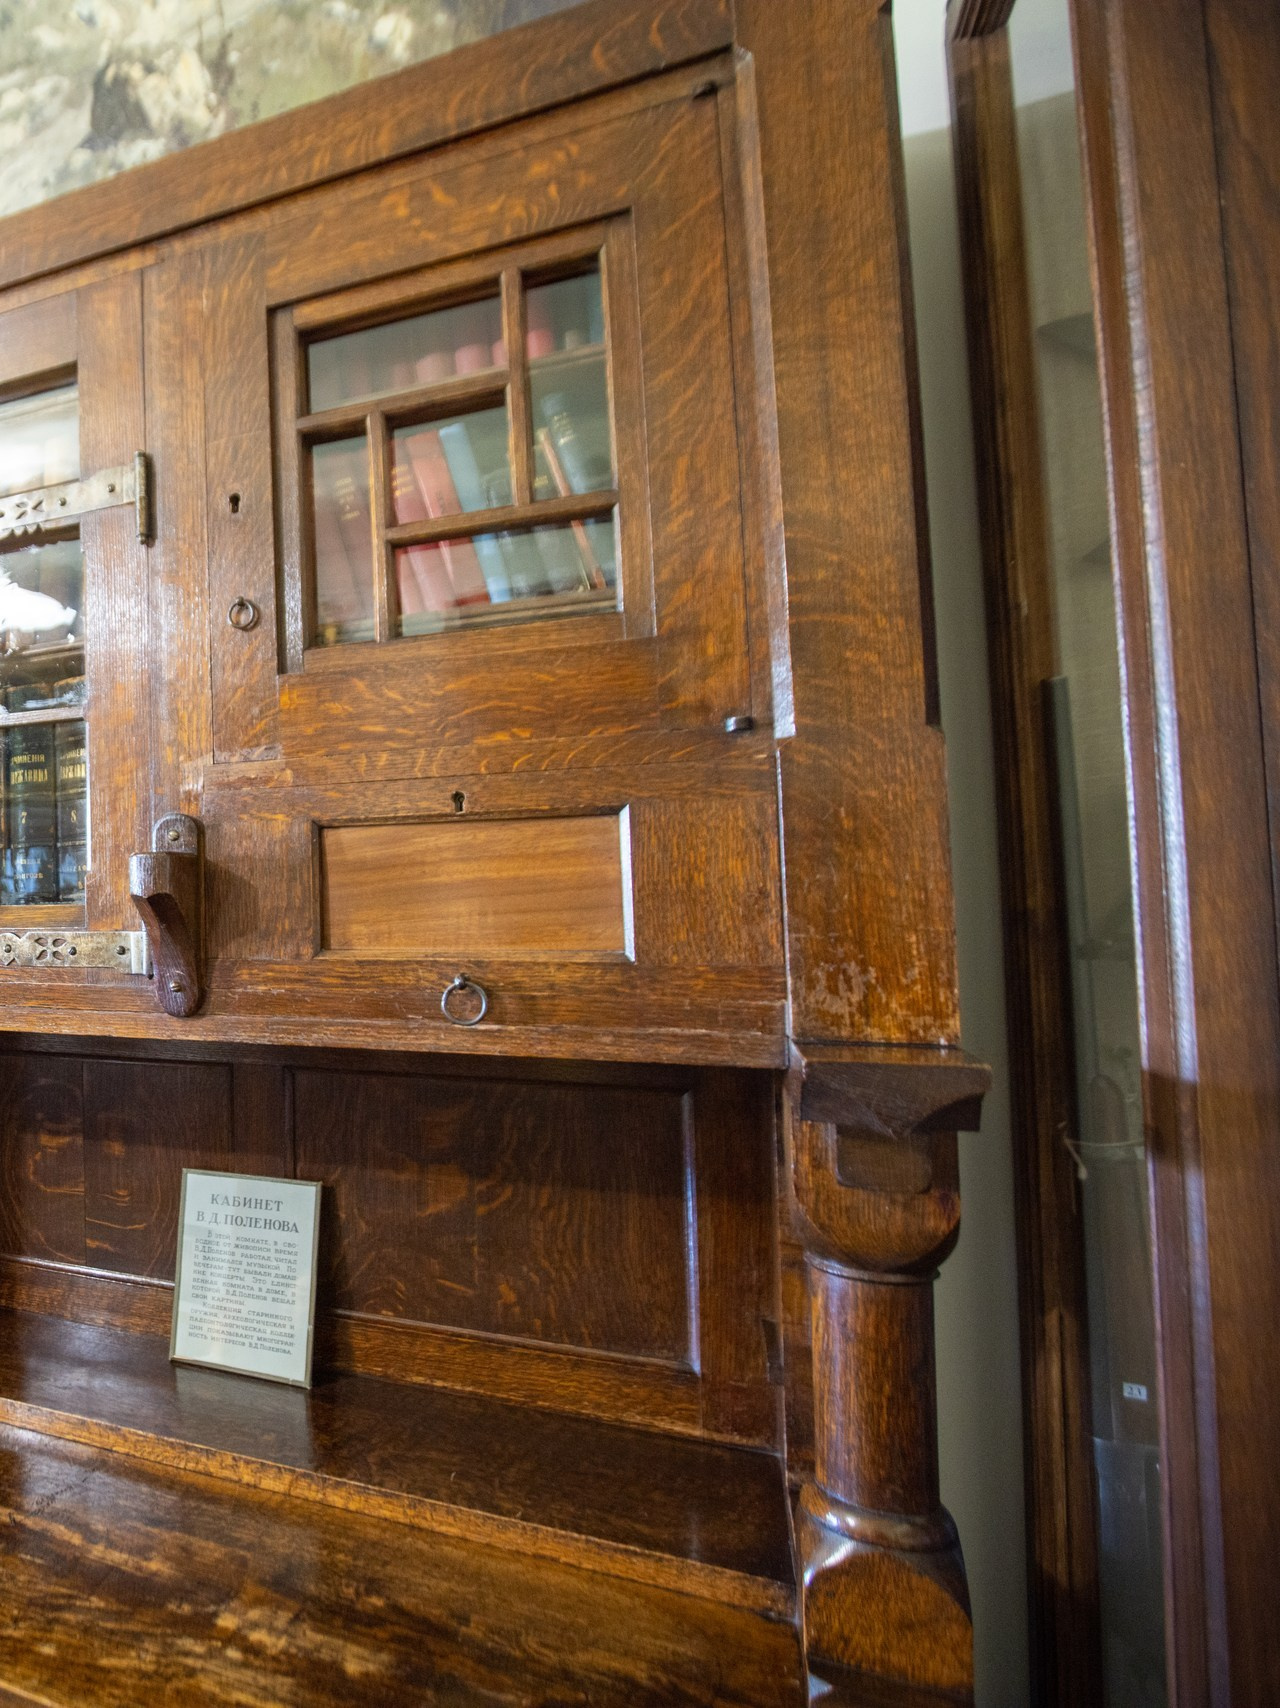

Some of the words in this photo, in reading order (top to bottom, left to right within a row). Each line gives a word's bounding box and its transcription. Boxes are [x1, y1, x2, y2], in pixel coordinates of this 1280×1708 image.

[20, 811, 28, 824] 7
[70, 809, 77, 823] 8
[211, 1194, 284, 1212] КАБИНЕТ
[224, 1214, 300, 1234] ПОЛЕНОВА
[207, 1230, 213, 1238] В
[195, 1238, 220, 1247] БОДНОЕ
[234, 1243, 271, 1253] ЖИВОПИСИ
[274, 1249, 298, 1257] ВРЕМЯ
[202, 1256, 243, 1265] ЗАНИМАЛСЯ
[274, 1257, 297, 1265] ЧИТАЛ
[194, 1262, 224, 1270] ВЕЧЕРАМ
[244, 1269, 272, 1278] БЫВАЛИ
[192, 1278, 218, 1286] ВЕННАЯ
[222, 1282, 255, 1291] КОМНАТА
[192, 1284, 220, 1294] КОТОРОЙ
[272, 1297, 296, 1306] ВЕШАЛ
[202, 1302, 242, 1313] КОЛЛЕКЦИЯ
[247, 1310, 293, 1322] СТАРИННОГО
[189, 1317, 267, 1334] ПАЛЕОНТОЛОГИЧЕСКАЯ
[223, 1314, 287, 1328] АРХЕОЛОГИЧЕСКАЯ
[188, 1332, 208, 1340] НОСТЬ
[211, 1336, 246, 1347] ИНТЕРЕСОВ
[207, 1327, 254, 1340] ПОКАЗЫВАЮТ
